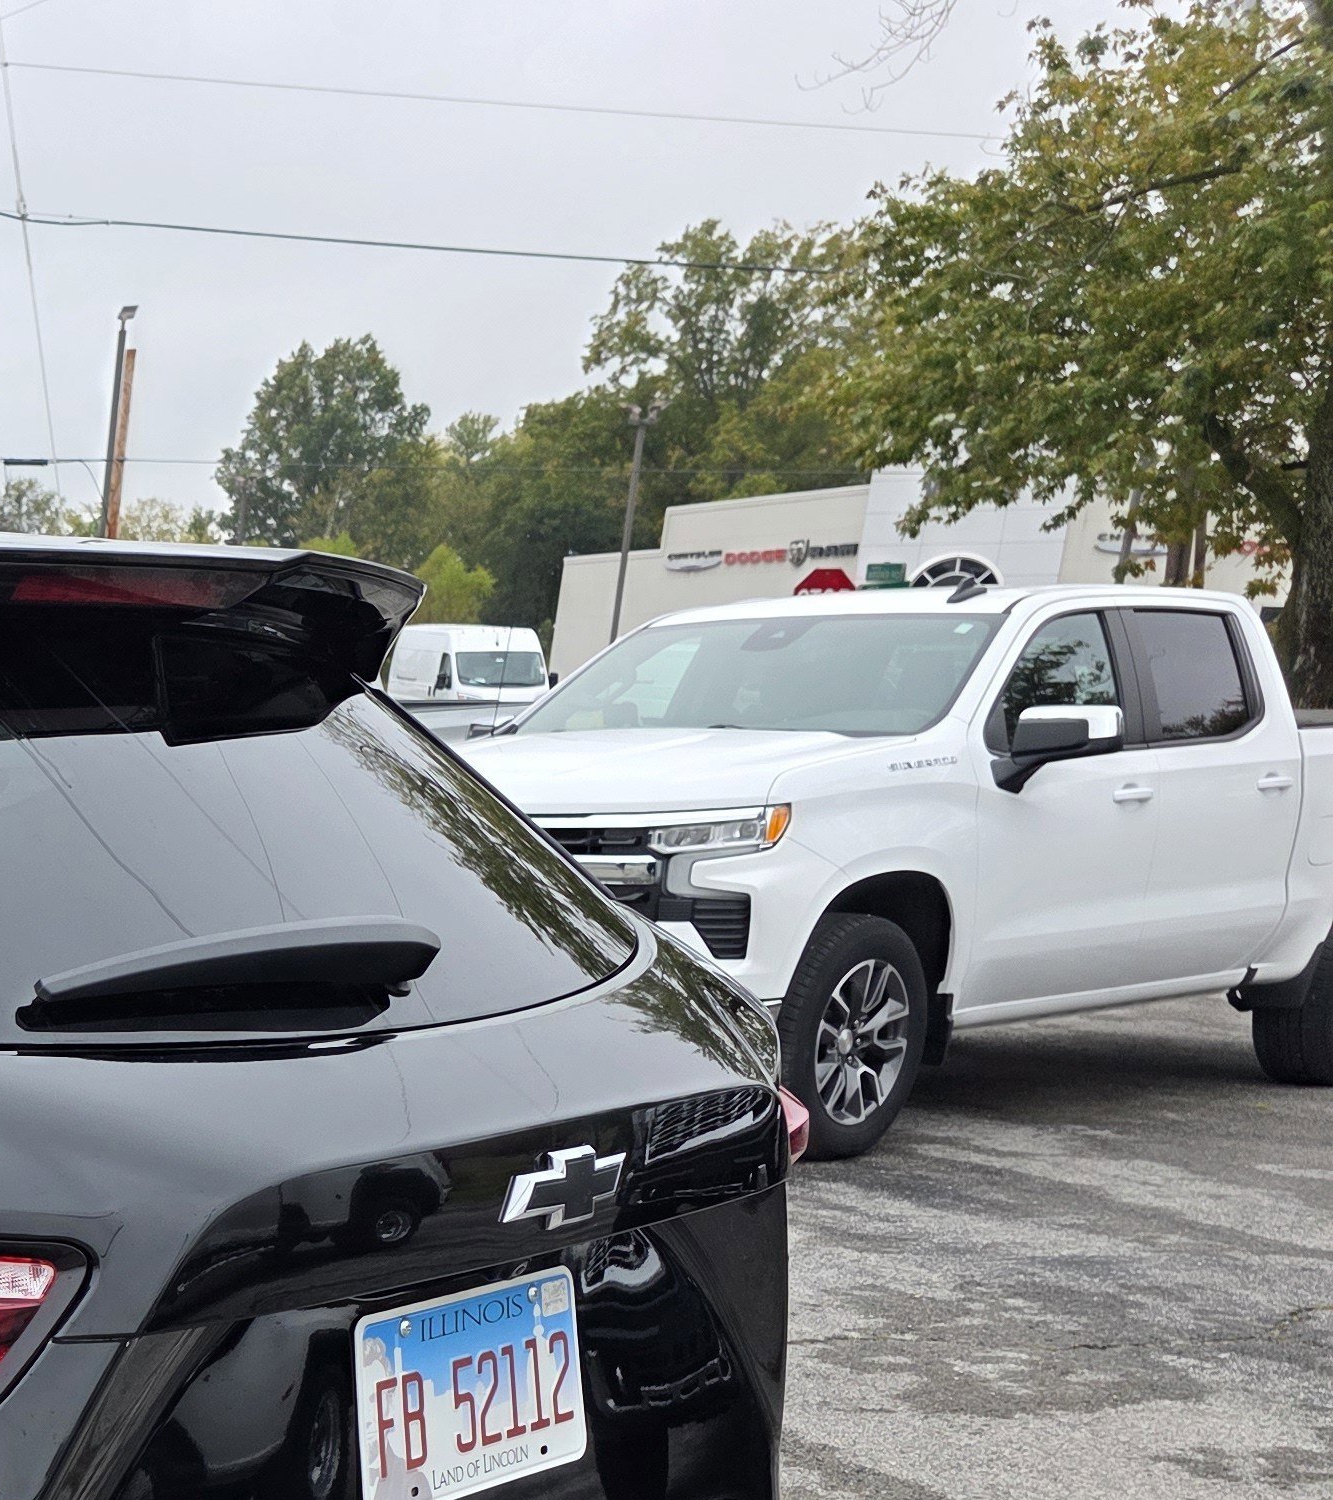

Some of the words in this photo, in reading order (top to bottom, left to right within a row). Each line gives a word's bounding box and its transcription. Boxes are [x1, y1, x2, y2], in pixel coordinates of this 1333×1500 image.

[724, 549, 787, 566] DODGE
[808, 543, 859, 559] RAM
[419, 1293, 524, 1343] ILLINOIS
[375, 1370, 429, 1480] FB
[451, 1330, 575, 1455] 52112
[432, 1464, 465, 1491] LAND
[466, 1461, 481, 1479] OF
[482, 1443, 530, 1474] LINCOLN
